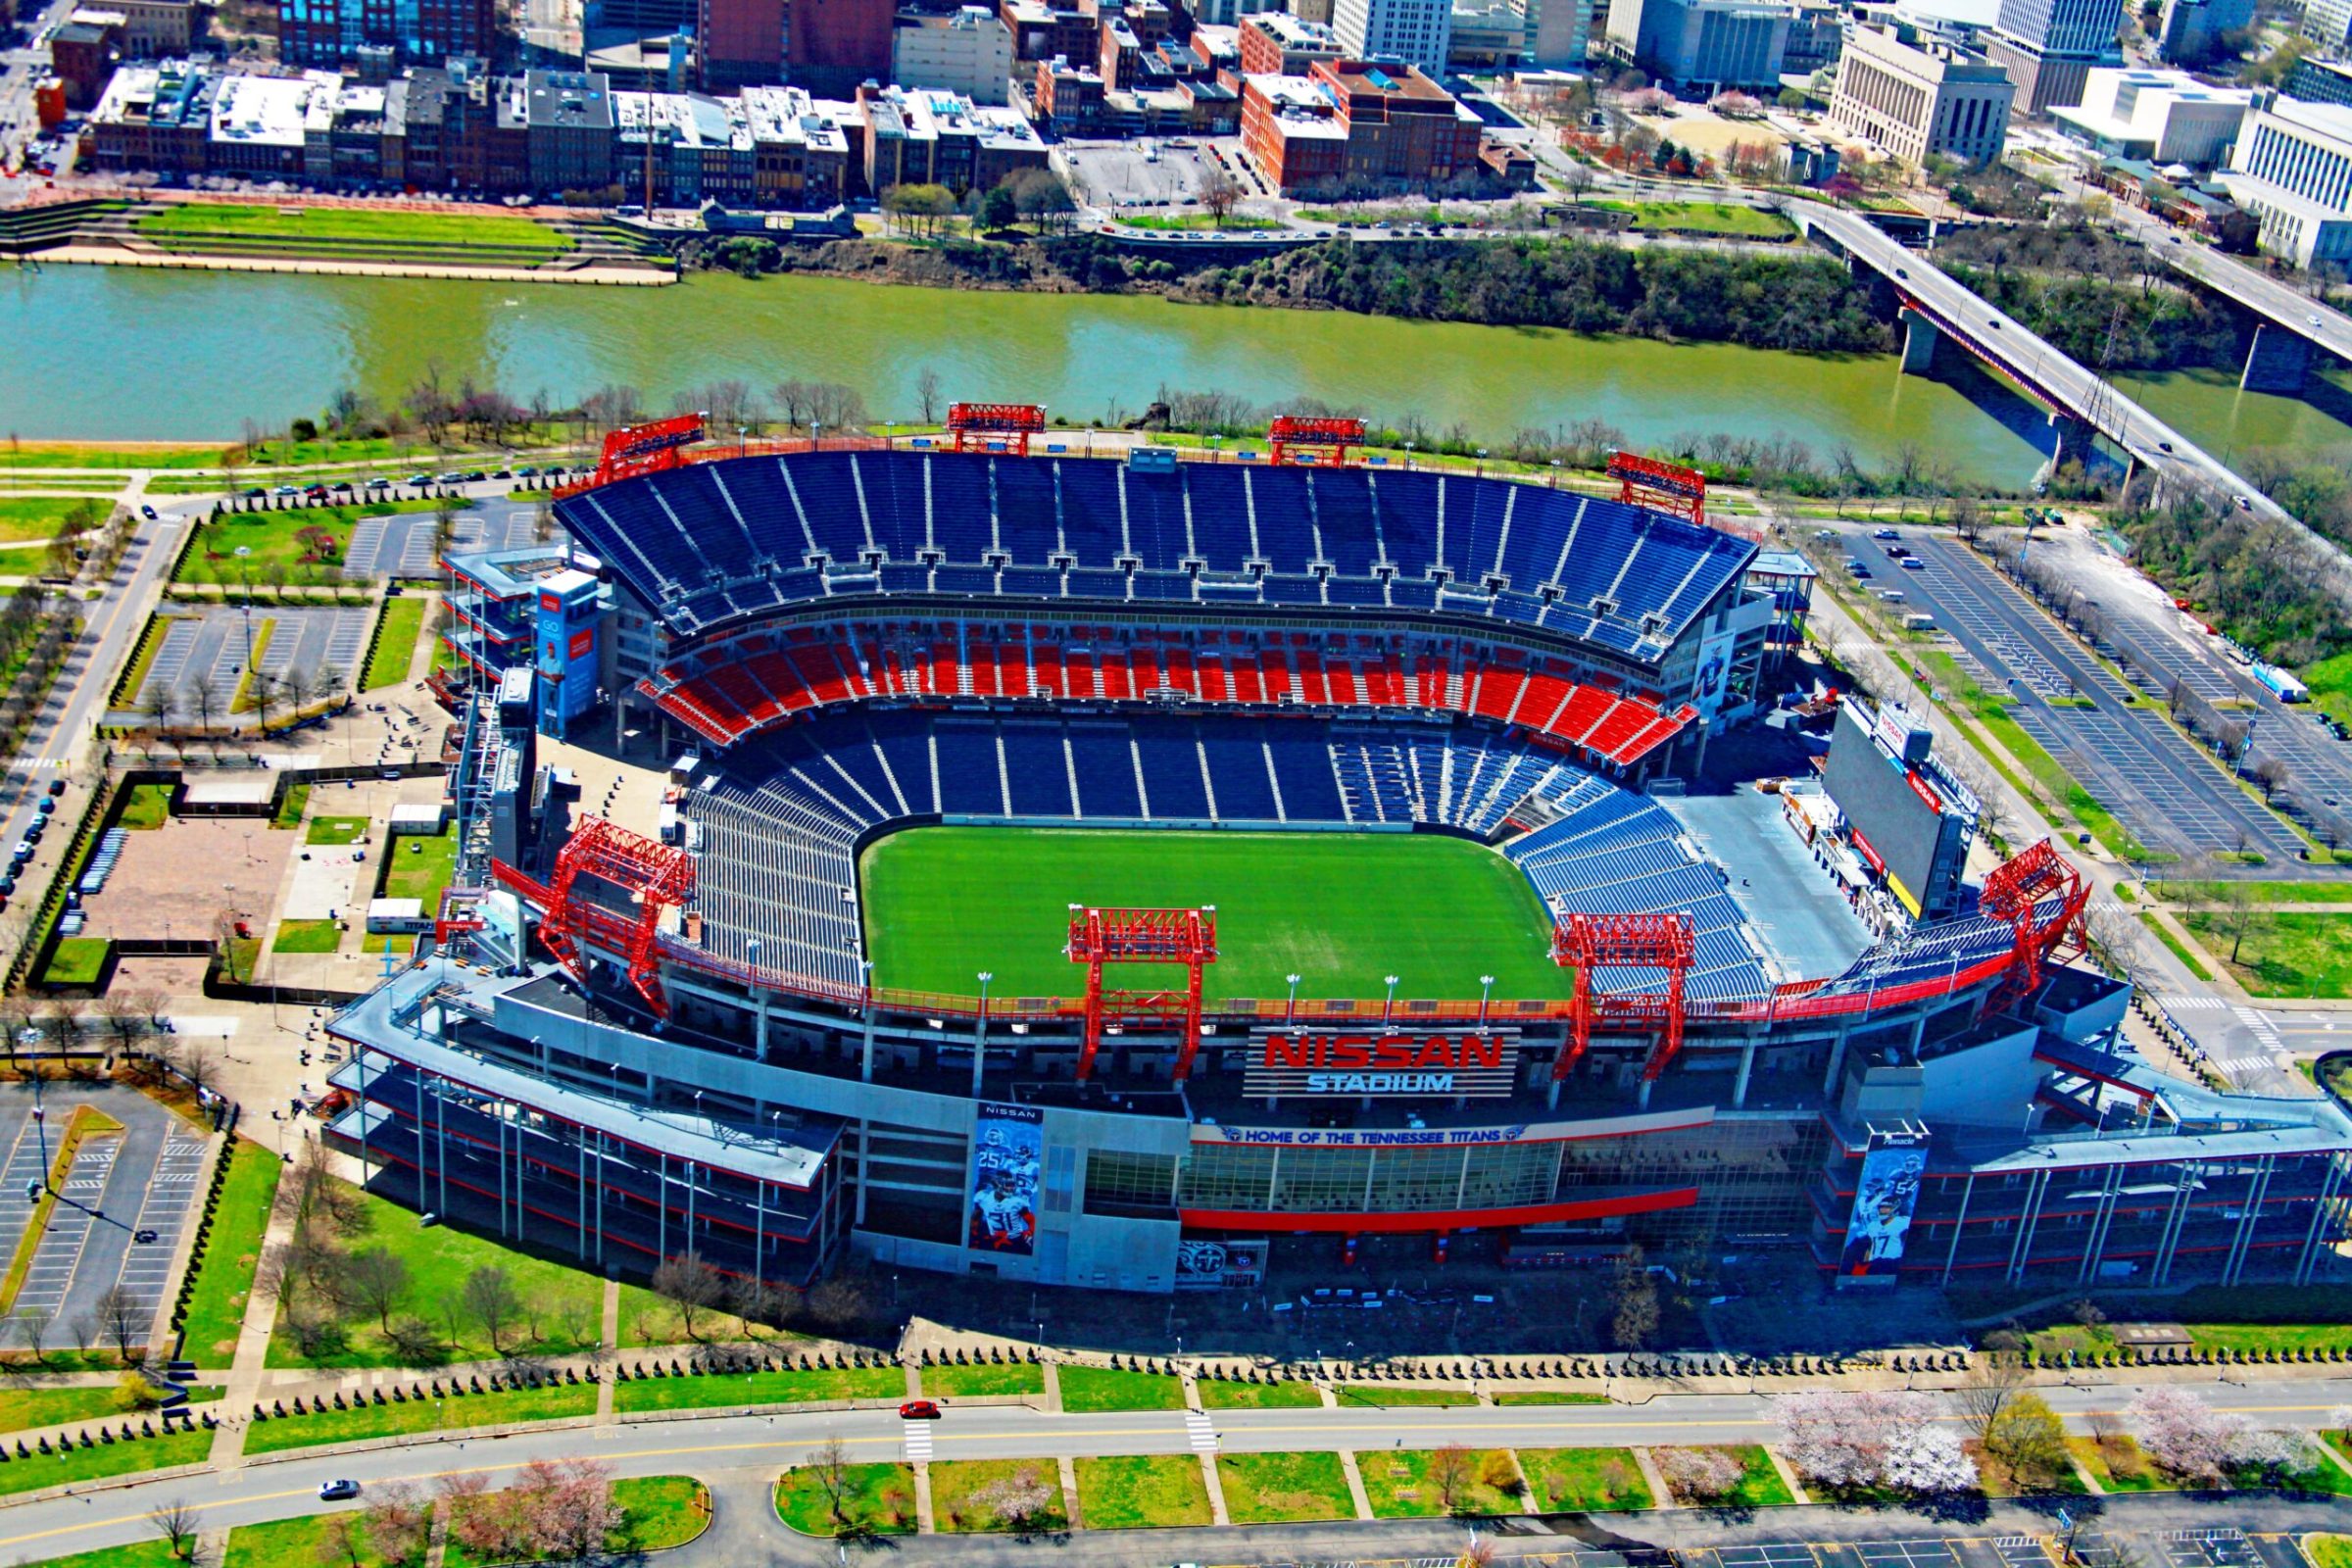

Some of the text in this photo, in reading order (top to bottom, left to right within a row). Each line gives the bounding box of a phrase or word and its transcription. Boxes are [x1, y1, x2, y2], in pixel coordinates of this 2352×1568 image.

[543, 619, 559, 632] GO
[1882, 714, 1903, 743] NISSAN
[1912, 776, 1936, 808] NISSAN
[1264, 1035, 1504, 1068] NISSAN
[1306, 1073, 1454, 1093] STADIUM
[986, 1106, 1036, 1118] NISSAN
[1246, 1130, 1500, 1145] HOME OF THE TENNESSEE TITANS
[1883, 1137, 1915, 1146] Pinnacle
[979, 1152, 1000, 1168] 25
[988, 1212, 1013, 1232] 31
[1873, 1235, 1890, 1255] 17
